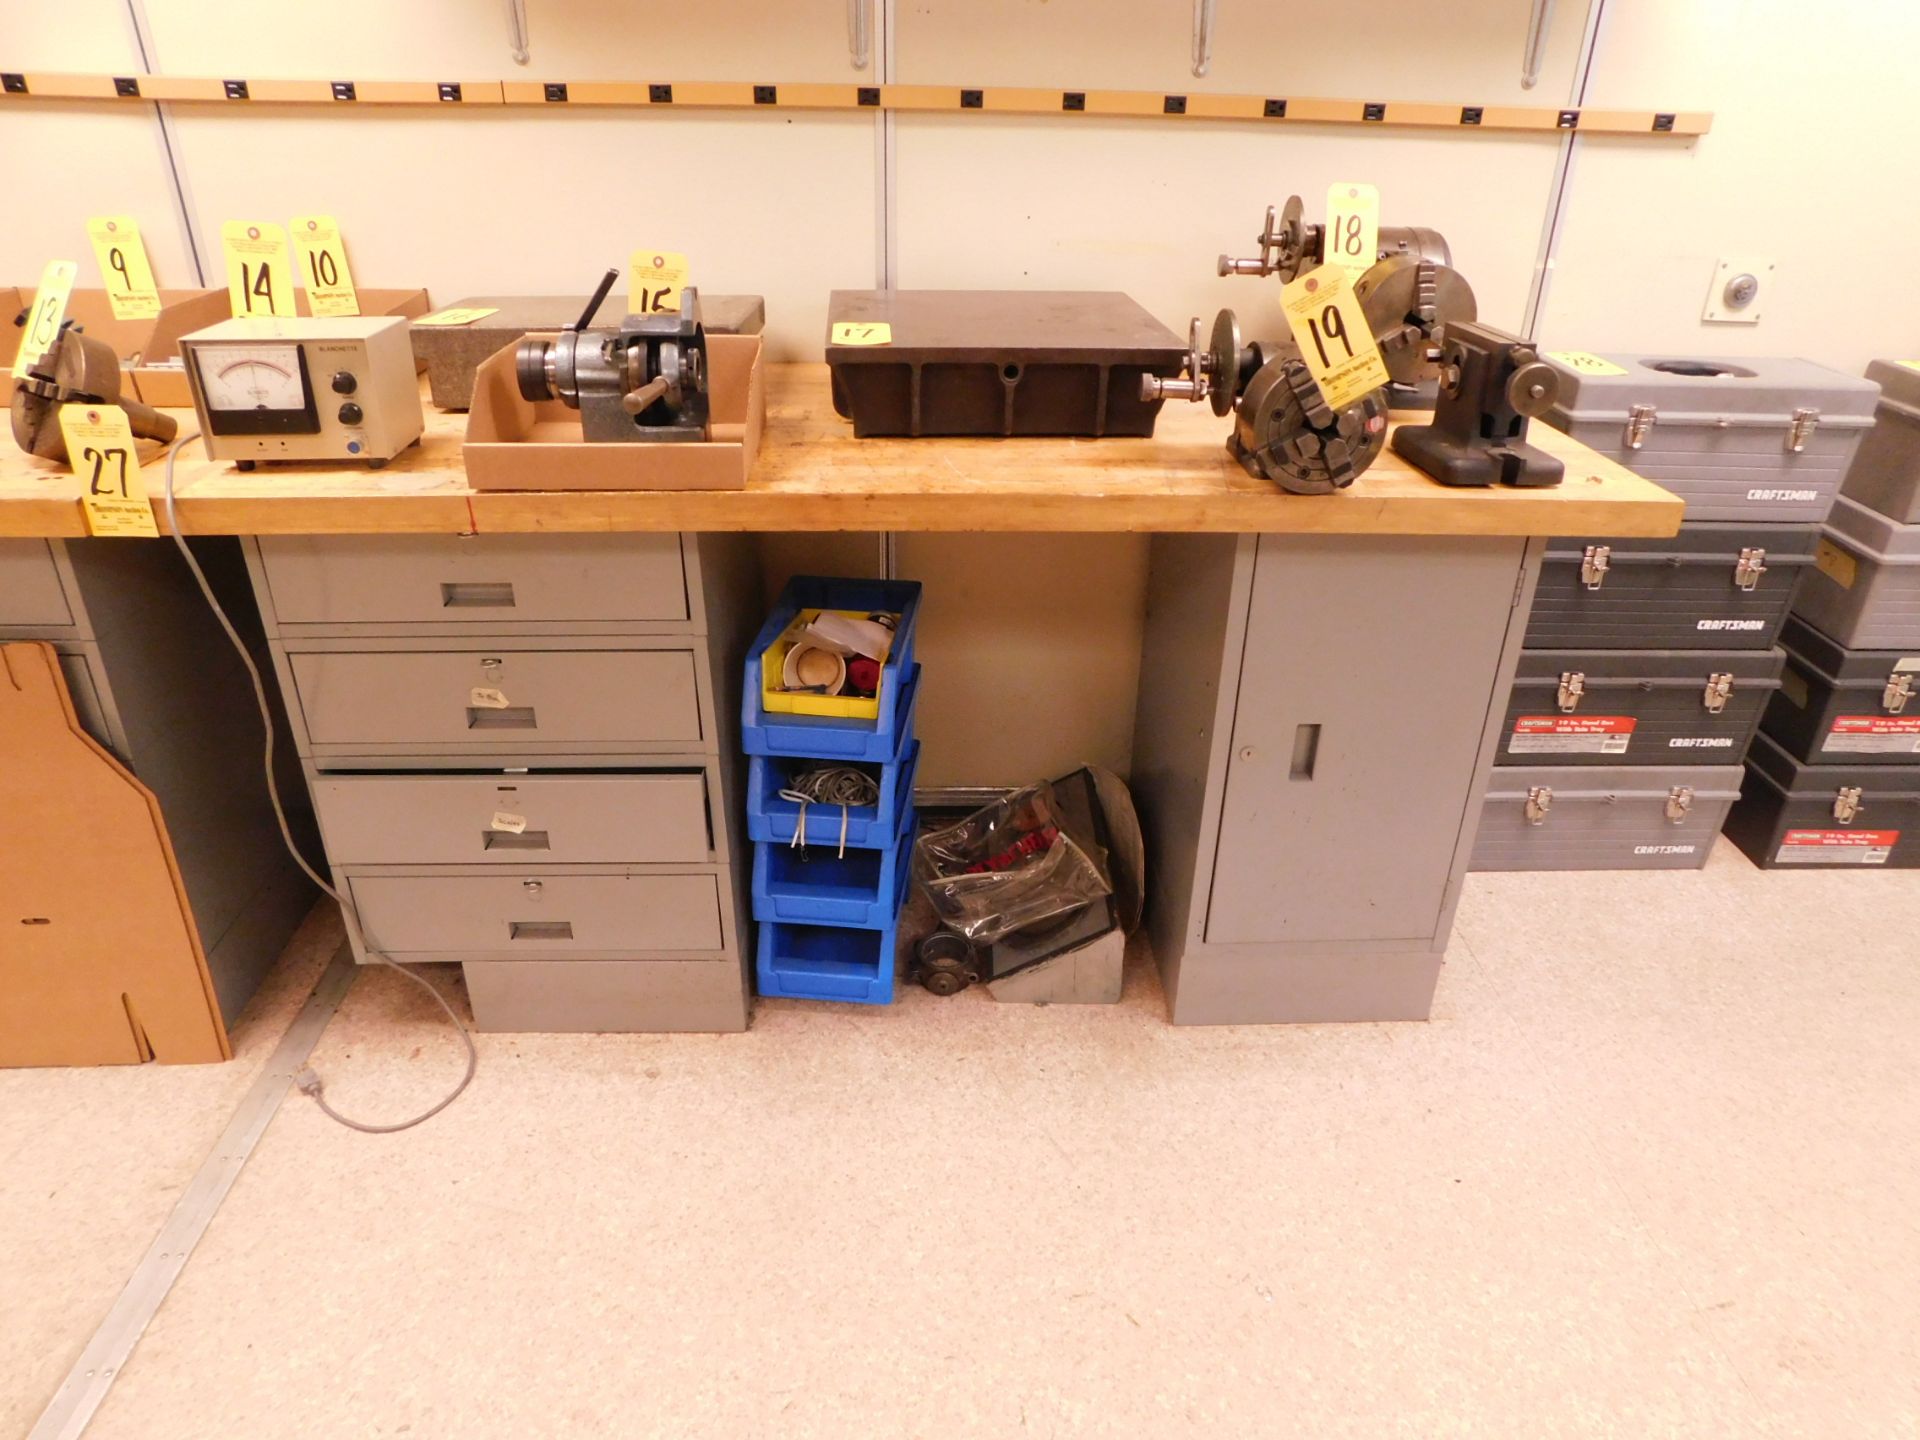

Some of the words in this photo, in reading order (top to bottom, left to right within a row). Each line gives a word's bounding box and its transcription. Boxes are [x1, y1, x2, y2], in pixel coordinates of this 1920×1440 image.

[1333, 214, 1362, 256] 18
[110, 247, 132, 292] 9
[241, 261, 275, 315] 14
[309, 249, 339, 288] 10
[29, 296, 57, 346] 13
[843, 328, 876, 339] 17
[1307, 304, 1355, 369] 19
[318, 345, 358, 353] BLANCHETTE
[83, 446, 128, 499] 27
[1746, 488, 1818, 501] CRAFTSMAN
[1696, 619, 1766, 631] CRAFTSMAN
[1668, 737, 1734, 748] CRAFTSMAN
[1633, 845, 1696, 855] CRAFTSMAN
